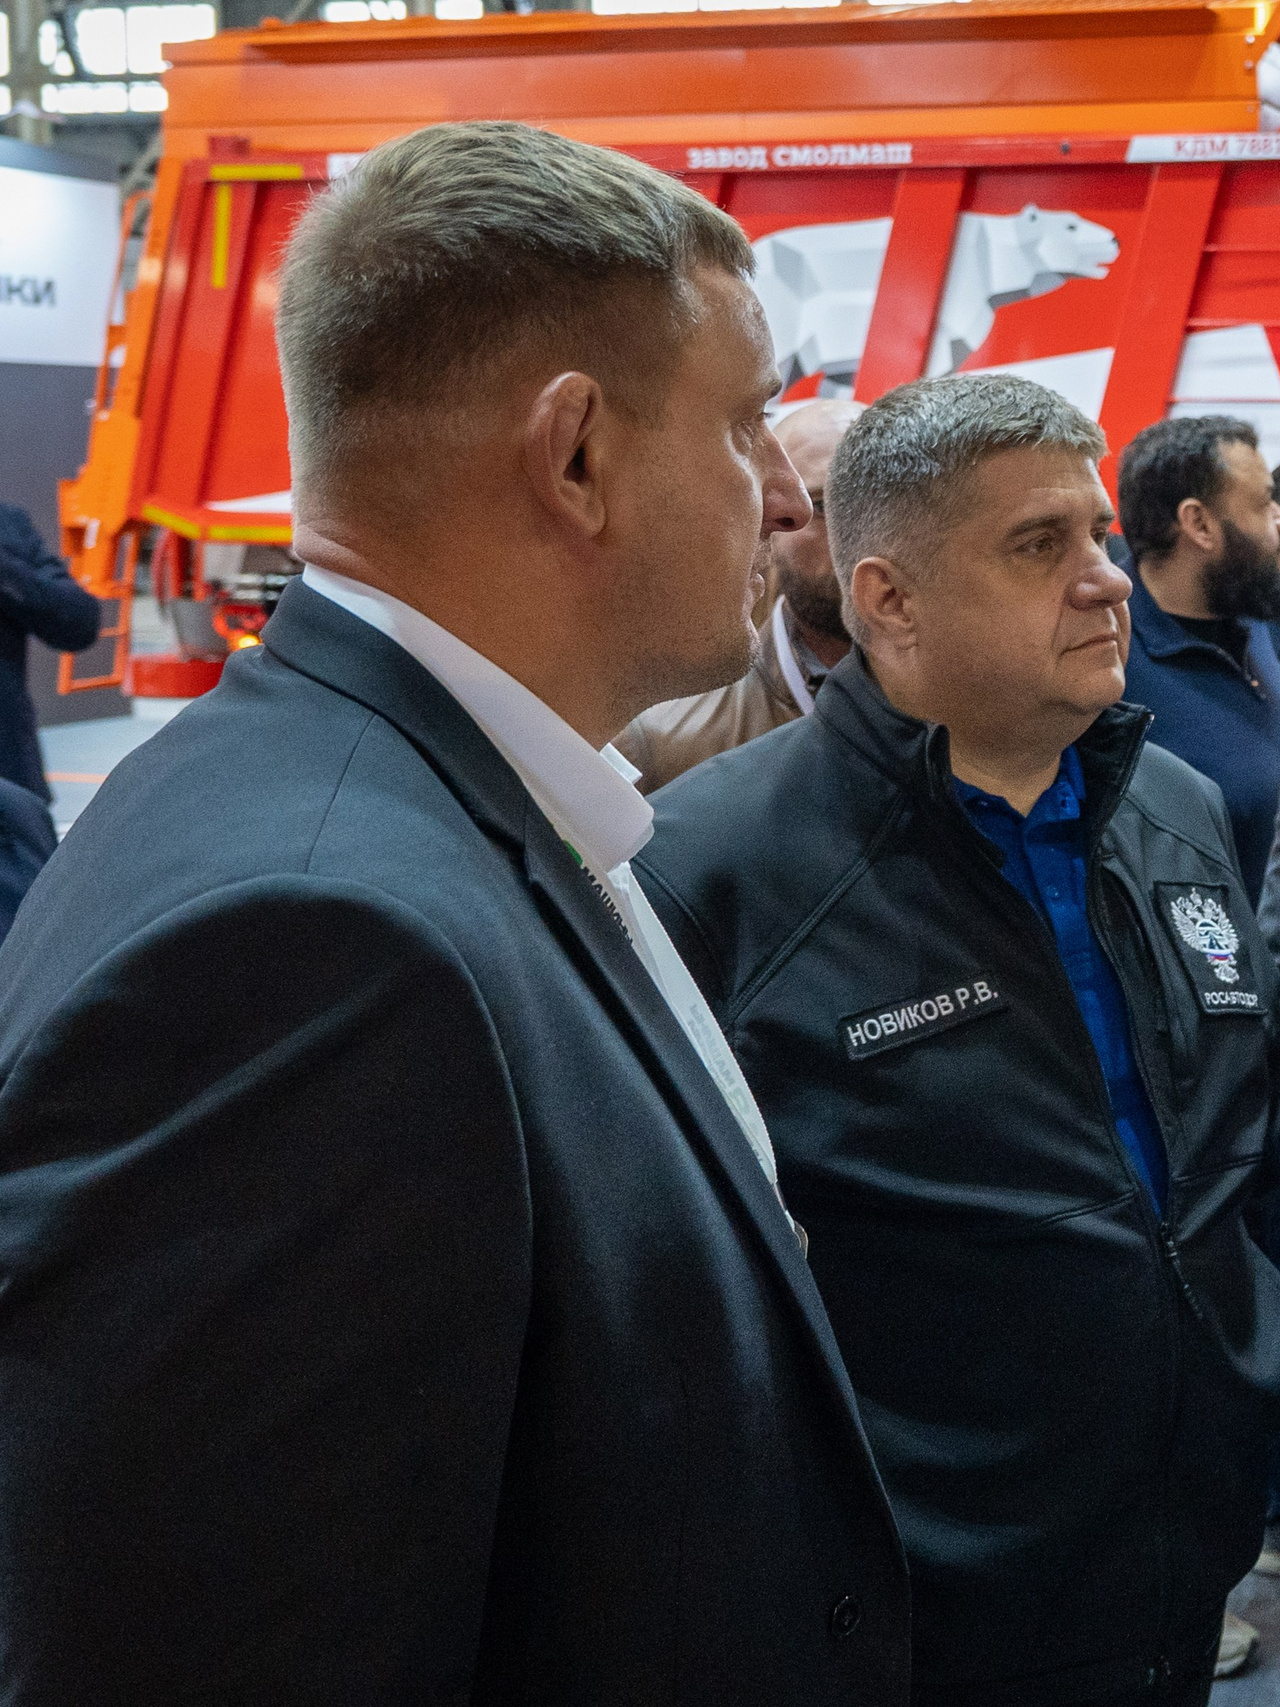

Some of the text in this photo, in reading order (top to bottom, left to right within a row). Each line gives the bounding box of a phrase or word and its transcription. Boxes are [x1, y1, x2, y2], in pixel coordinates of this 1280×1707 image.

[1175, 137, 1228, 158] КДМ
[847, 981, 999, 1047] НОВИКОВ Р.В.
